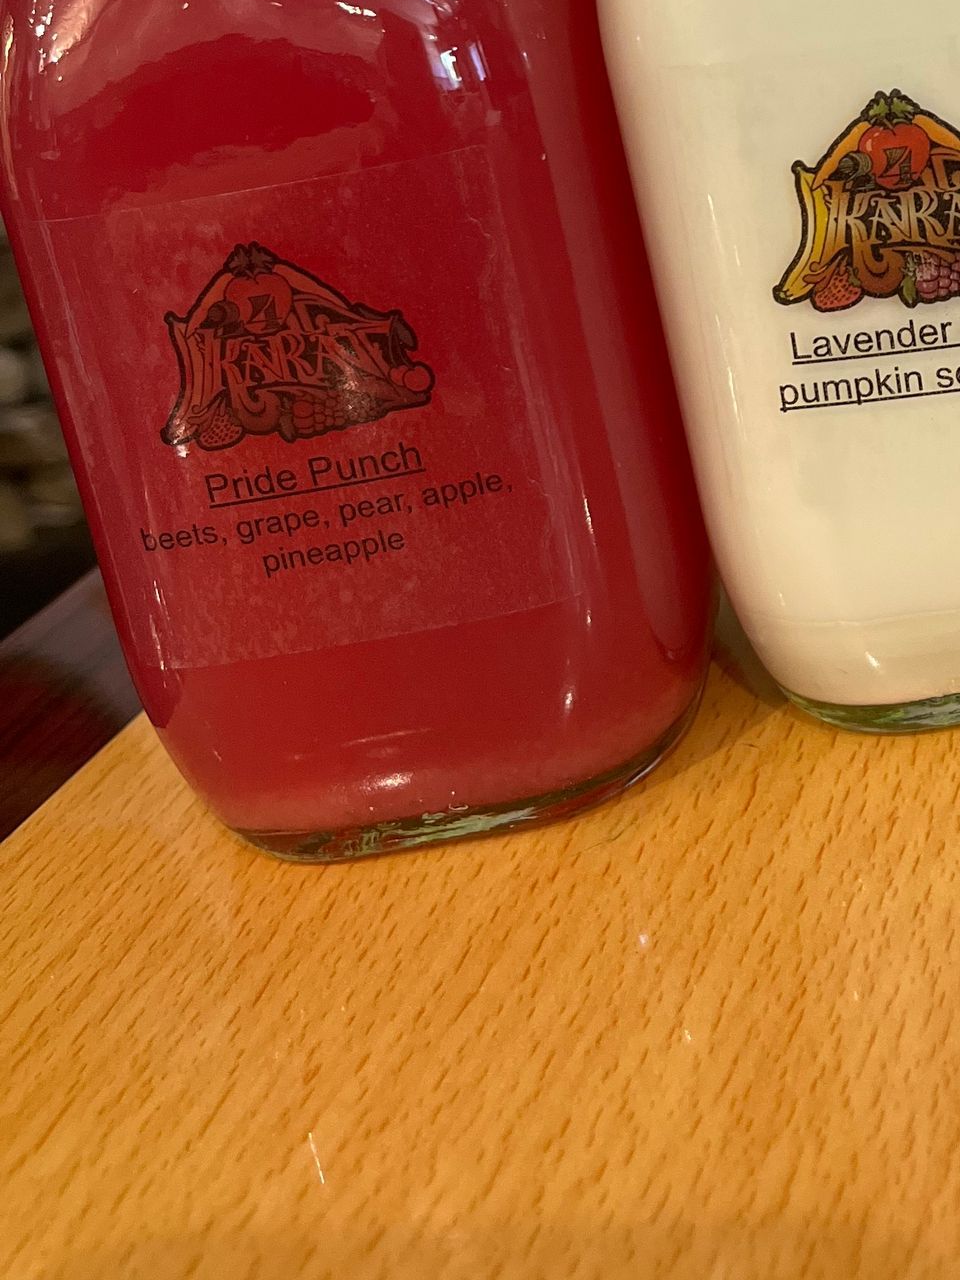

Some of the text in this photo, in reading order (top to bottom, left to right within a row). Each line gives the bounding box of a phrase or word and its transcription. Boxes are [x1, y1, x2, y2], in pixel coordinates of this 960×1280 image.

[790, 320, 952, 360] Lavender
[779, 366, 924, 412] pumpkin
[204, 442, 423, 504] Pride Punch
[140, 472, 513, 552] beets, grape, pear, apple,
[262, 530, 406, 578] pineapple
